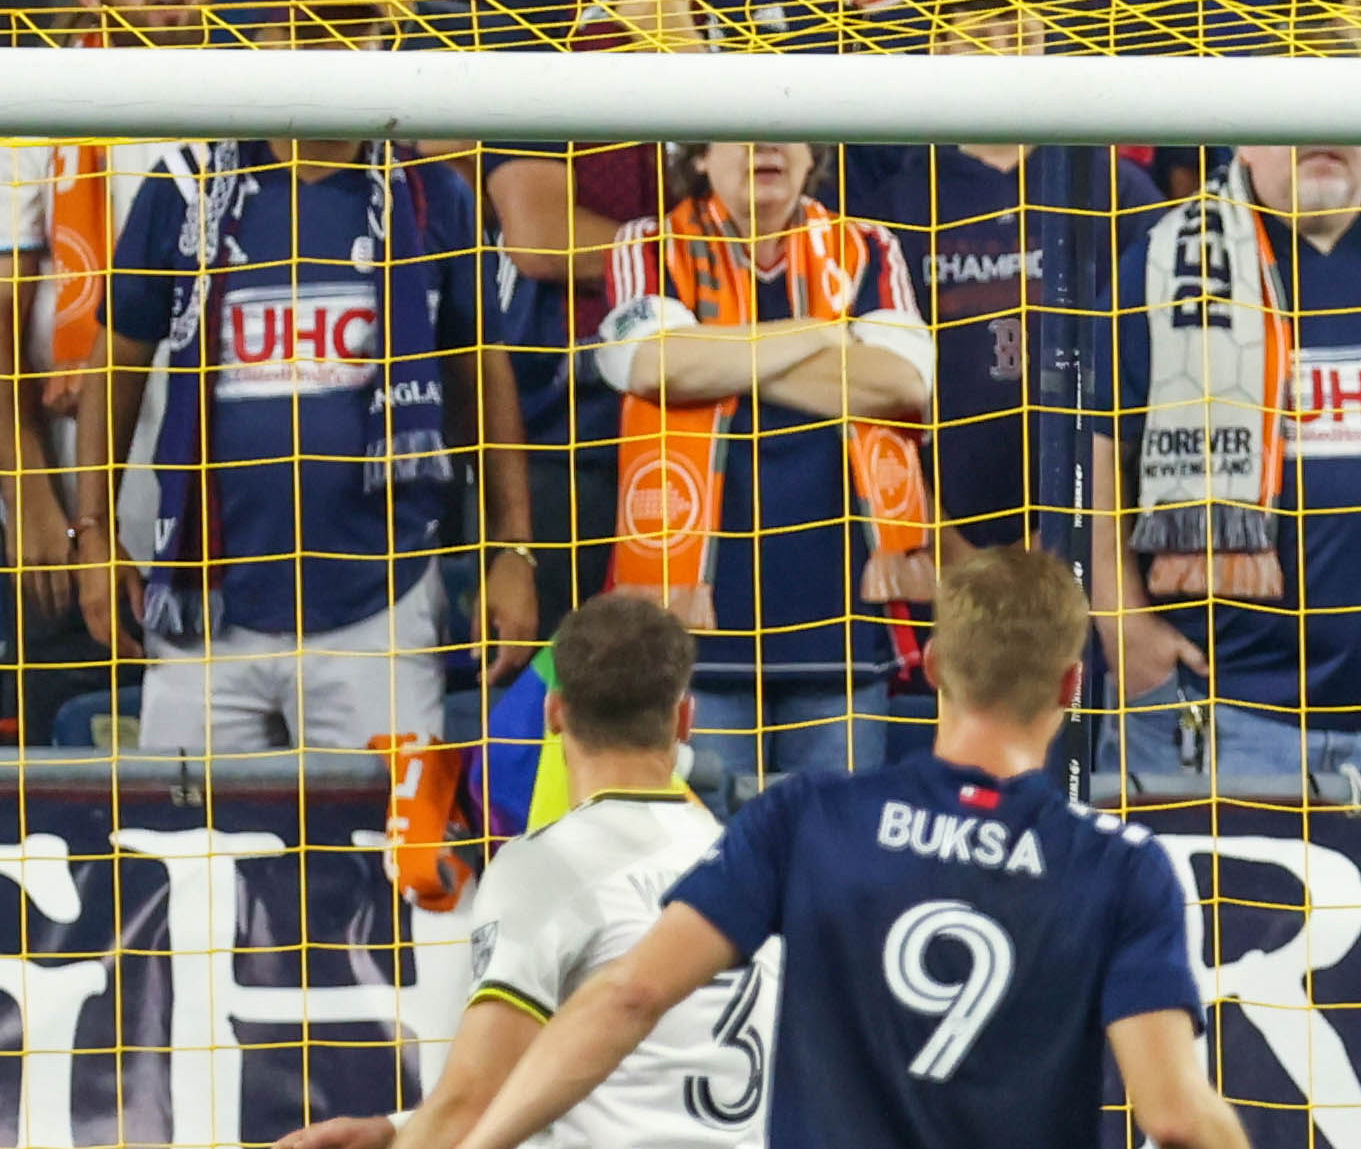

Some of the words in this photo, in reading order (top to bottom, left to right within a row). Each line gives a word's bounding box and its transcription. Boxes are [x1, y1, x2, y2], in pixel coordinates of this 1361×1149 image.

[231, 304, 377, 366] UHC
[1145, 426, 1252, 456] FOREVER
[877, 801, 1044, 878] BUKSA
[882, 899, 1014, 1082] 9
[683, 960, 764, 1132] 3
